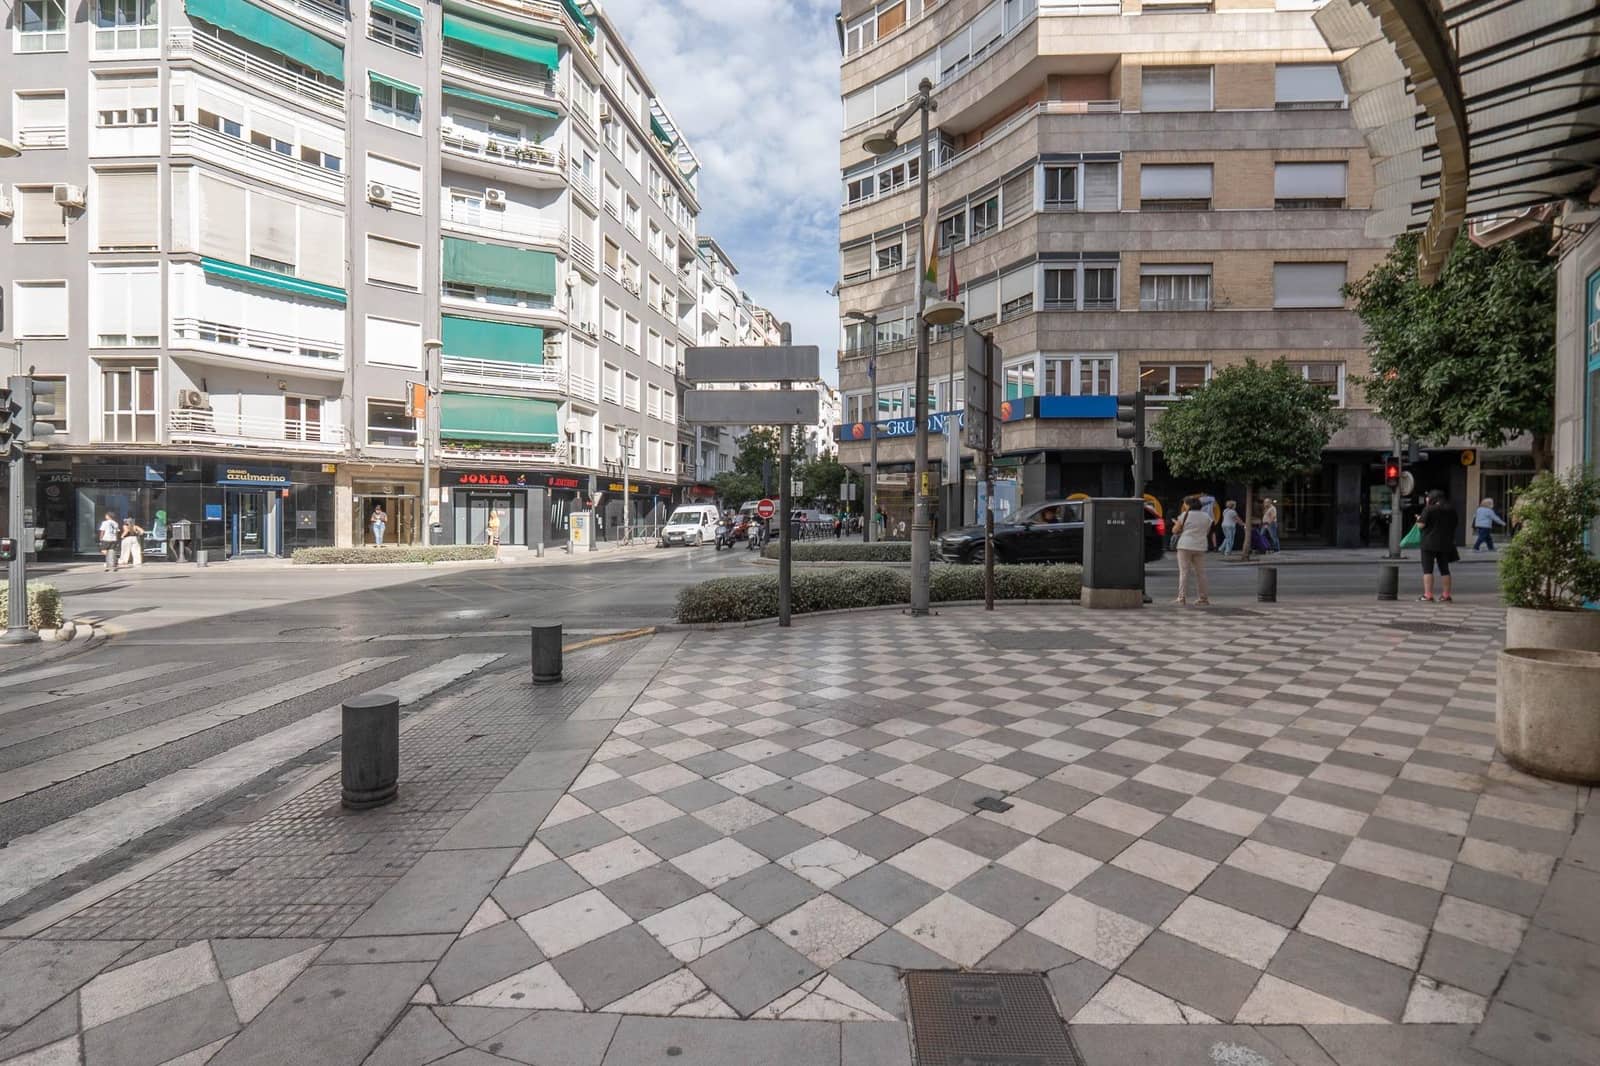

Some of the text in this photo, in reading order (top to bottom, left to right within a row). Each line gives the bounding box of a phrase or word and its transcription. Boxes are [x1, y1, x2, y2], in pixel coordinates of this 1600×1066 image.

[887, 419, 930, 435] GRU
[227, 473, 285, 482] azulmarino
[459, 473, 510, 485] JOKER
